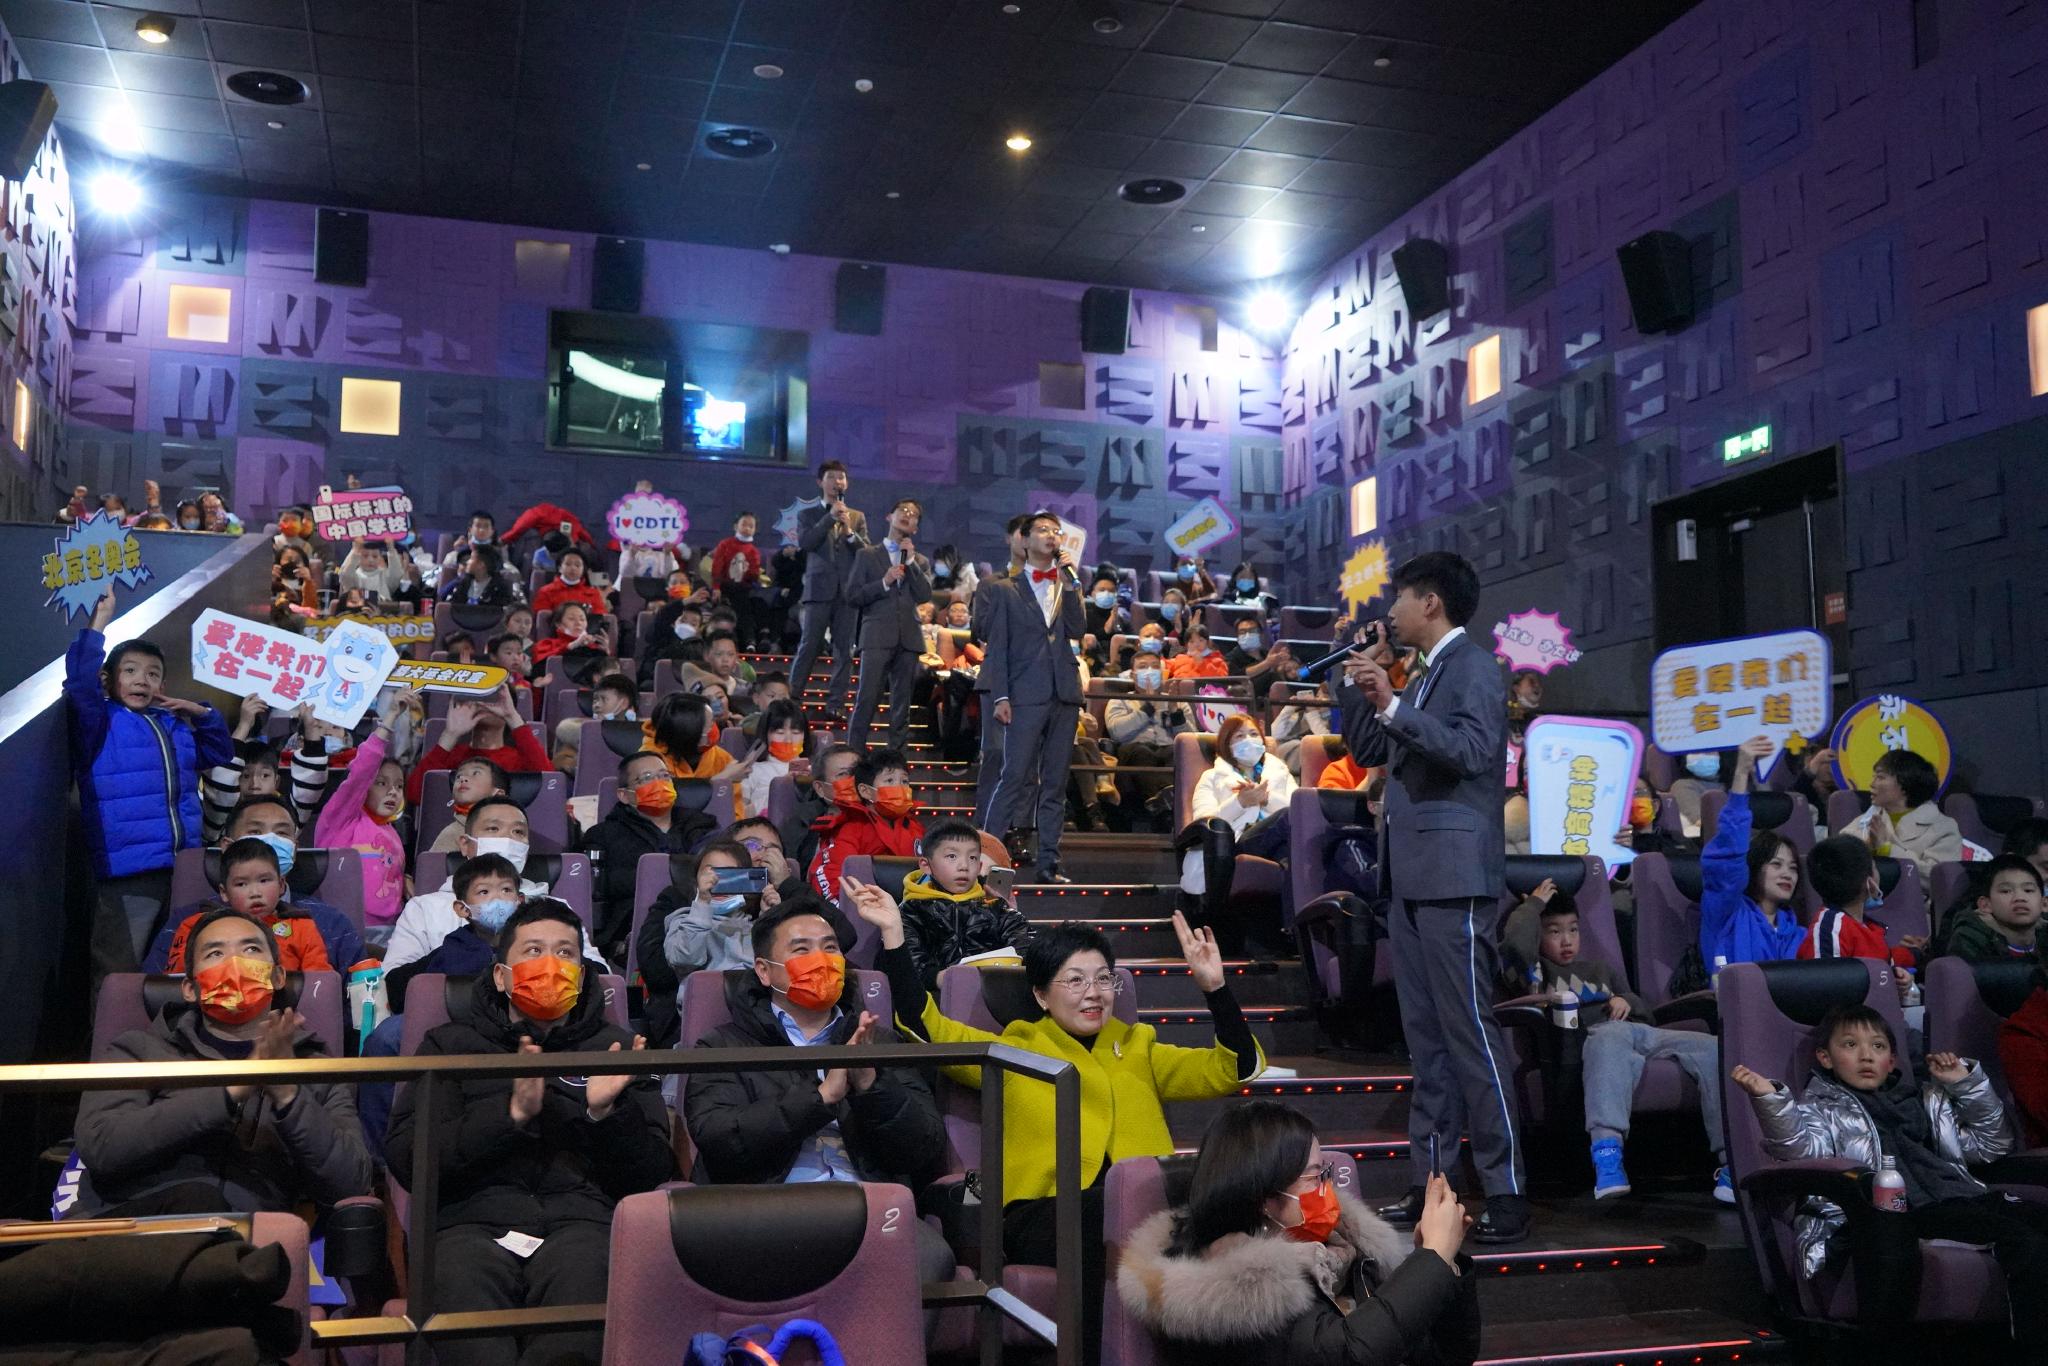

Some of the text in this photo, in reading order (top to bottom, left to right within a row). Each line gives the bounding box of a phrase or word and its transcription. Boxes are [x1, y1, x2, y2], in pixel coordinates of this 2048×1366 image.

[312, 495, 413, 523] 国际标准的
[327, 515, 408, 540] 中国学校
[616, 516, 680, 529] I CDTL
[203, 619, 327, 678] 爱使我们
[213, 651, 305, 701] 在一起
[1672, 651, 1809, 700] 爱使我们
[1691, 692, 1793, 733] 在一起
[547, 778, 557, 790] 2
[716, 785, 728, 797] 3
[338, 856, 345, 871] 1
[569, 862, 582, 876] 2
[1906, 864, 1915, 877] 7
[1879, 971, 1889, 986] 5
[313, 980, 322, 998] 1
[867, 981, 881, 998] 3
[1337, 1166, 1351, 1188] 3
[881, 1207, 900, 1233] 2
